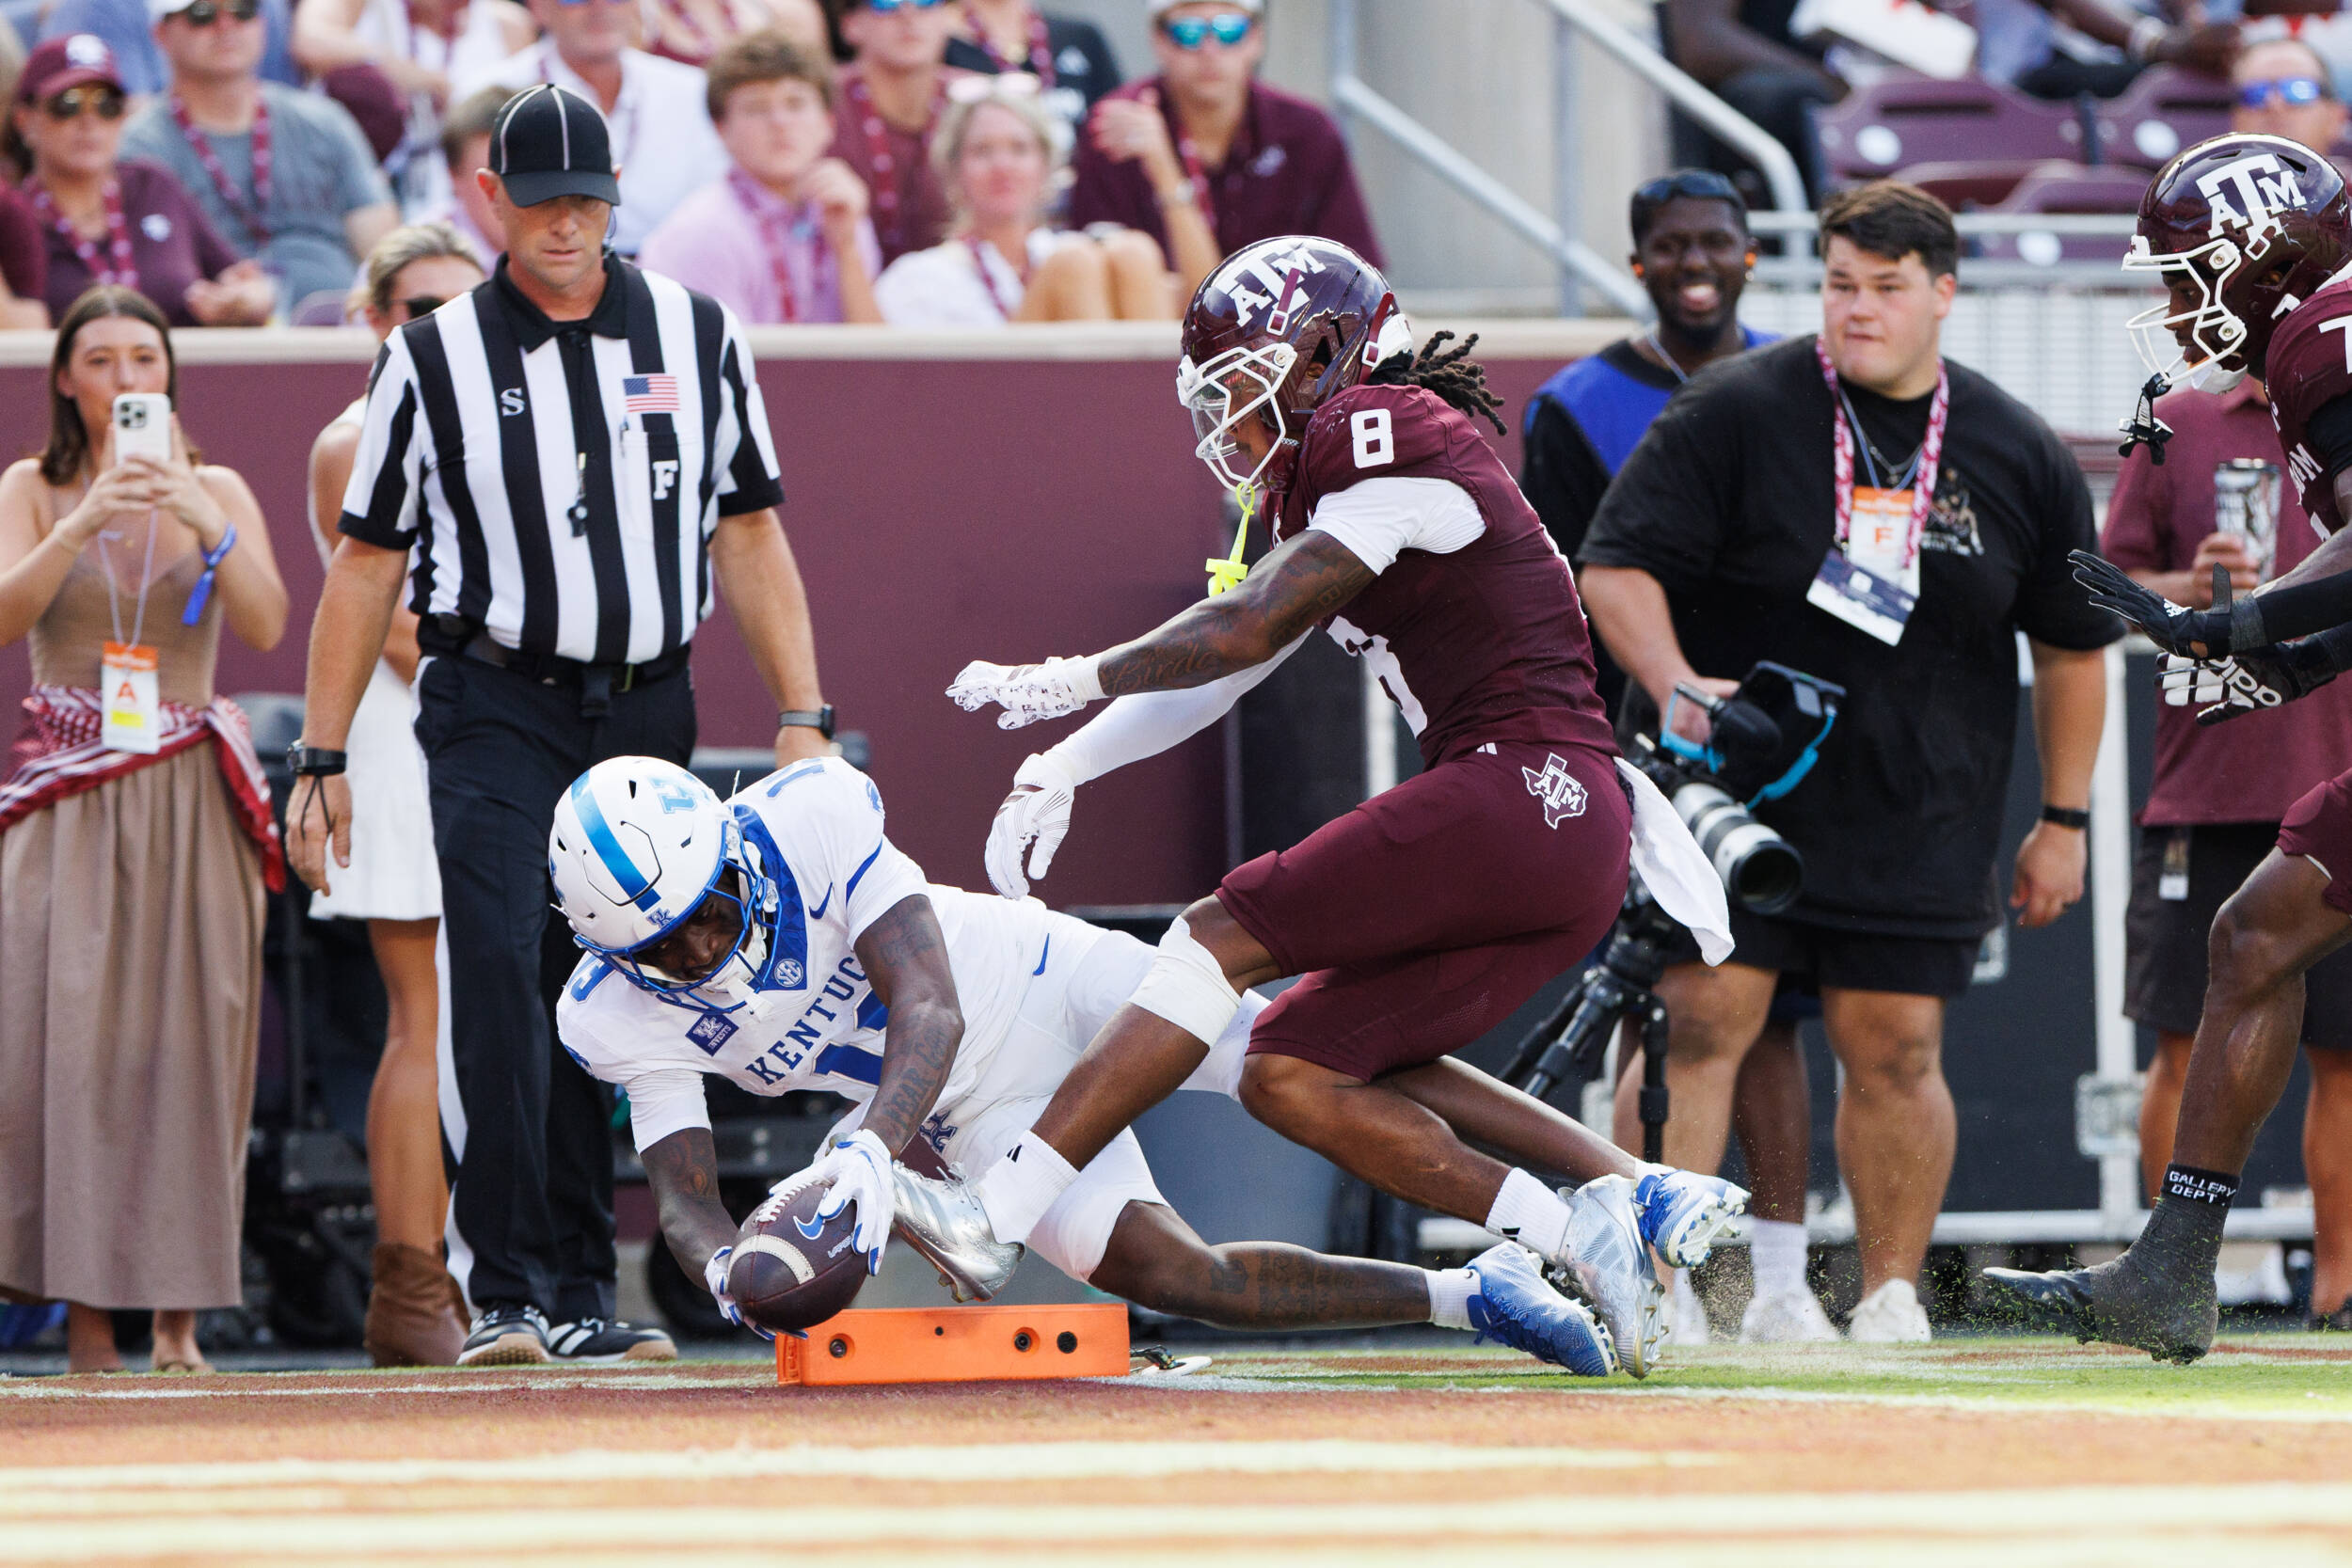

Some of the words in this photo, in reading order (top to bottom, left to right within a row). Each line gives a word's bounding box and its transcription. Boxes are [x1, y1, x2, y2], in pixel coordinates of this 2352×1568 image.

[500, 387, 526, 417] S
[1351, 408, 1394, 468] 8
[653, 459, 678, 500] F
[1874, 527, 1894, 546] F
[117, 680, 138, 704] A
[774, 958, 803, 987] SEC
[744, 956, 867, 1086] KENTUC
[707, 1024, 732, 1050] INVESTS
[2169, 1170, 2237, 1197] GALLERY
